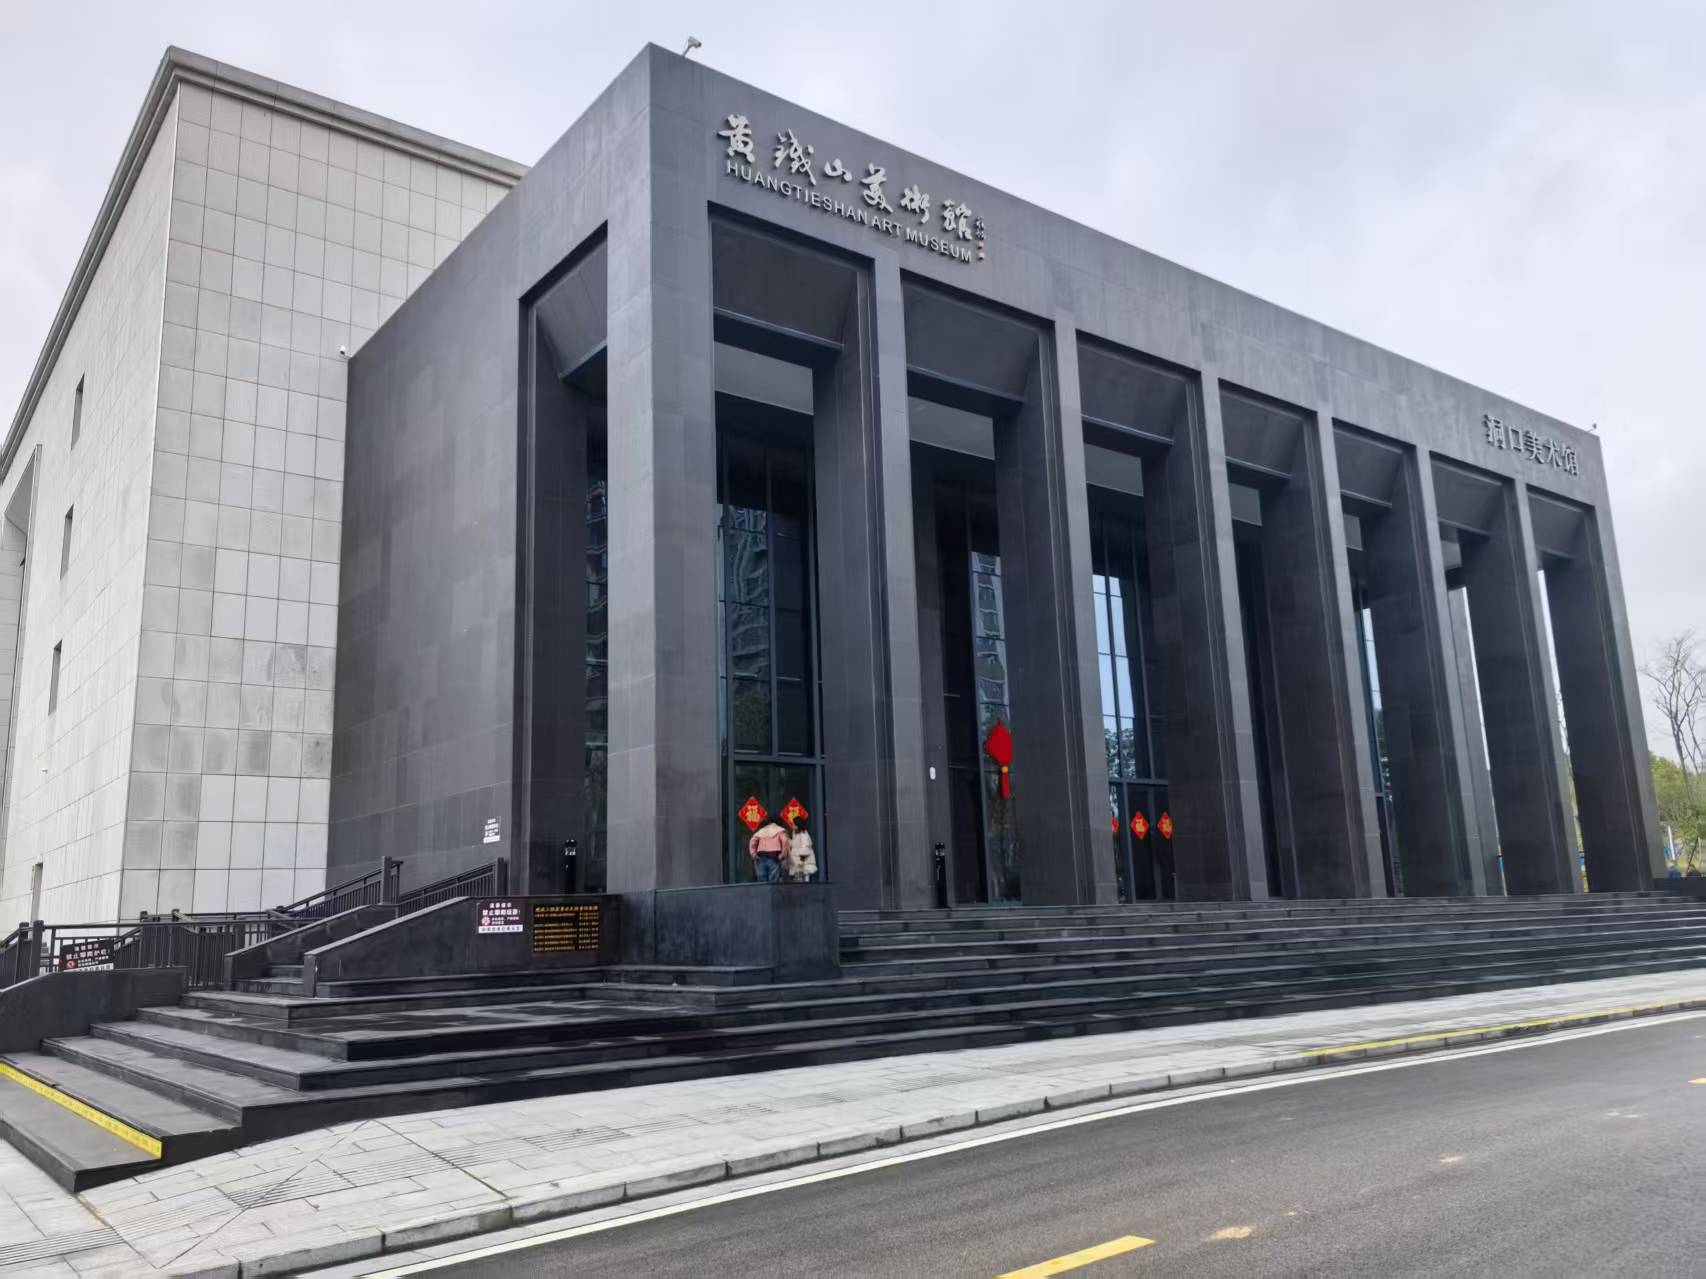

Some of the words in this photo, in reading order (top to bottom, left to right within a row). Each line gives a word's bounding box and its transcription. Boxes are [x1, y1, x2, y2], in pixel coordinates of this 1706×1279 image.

[727, 159, 868, 226] HUANGTIESHAN
[871, 214, 901, 237] ART
[905, 226, 972, 263] MUSEUM
[1484, 413, 1579, 477] 洞口美术馆
